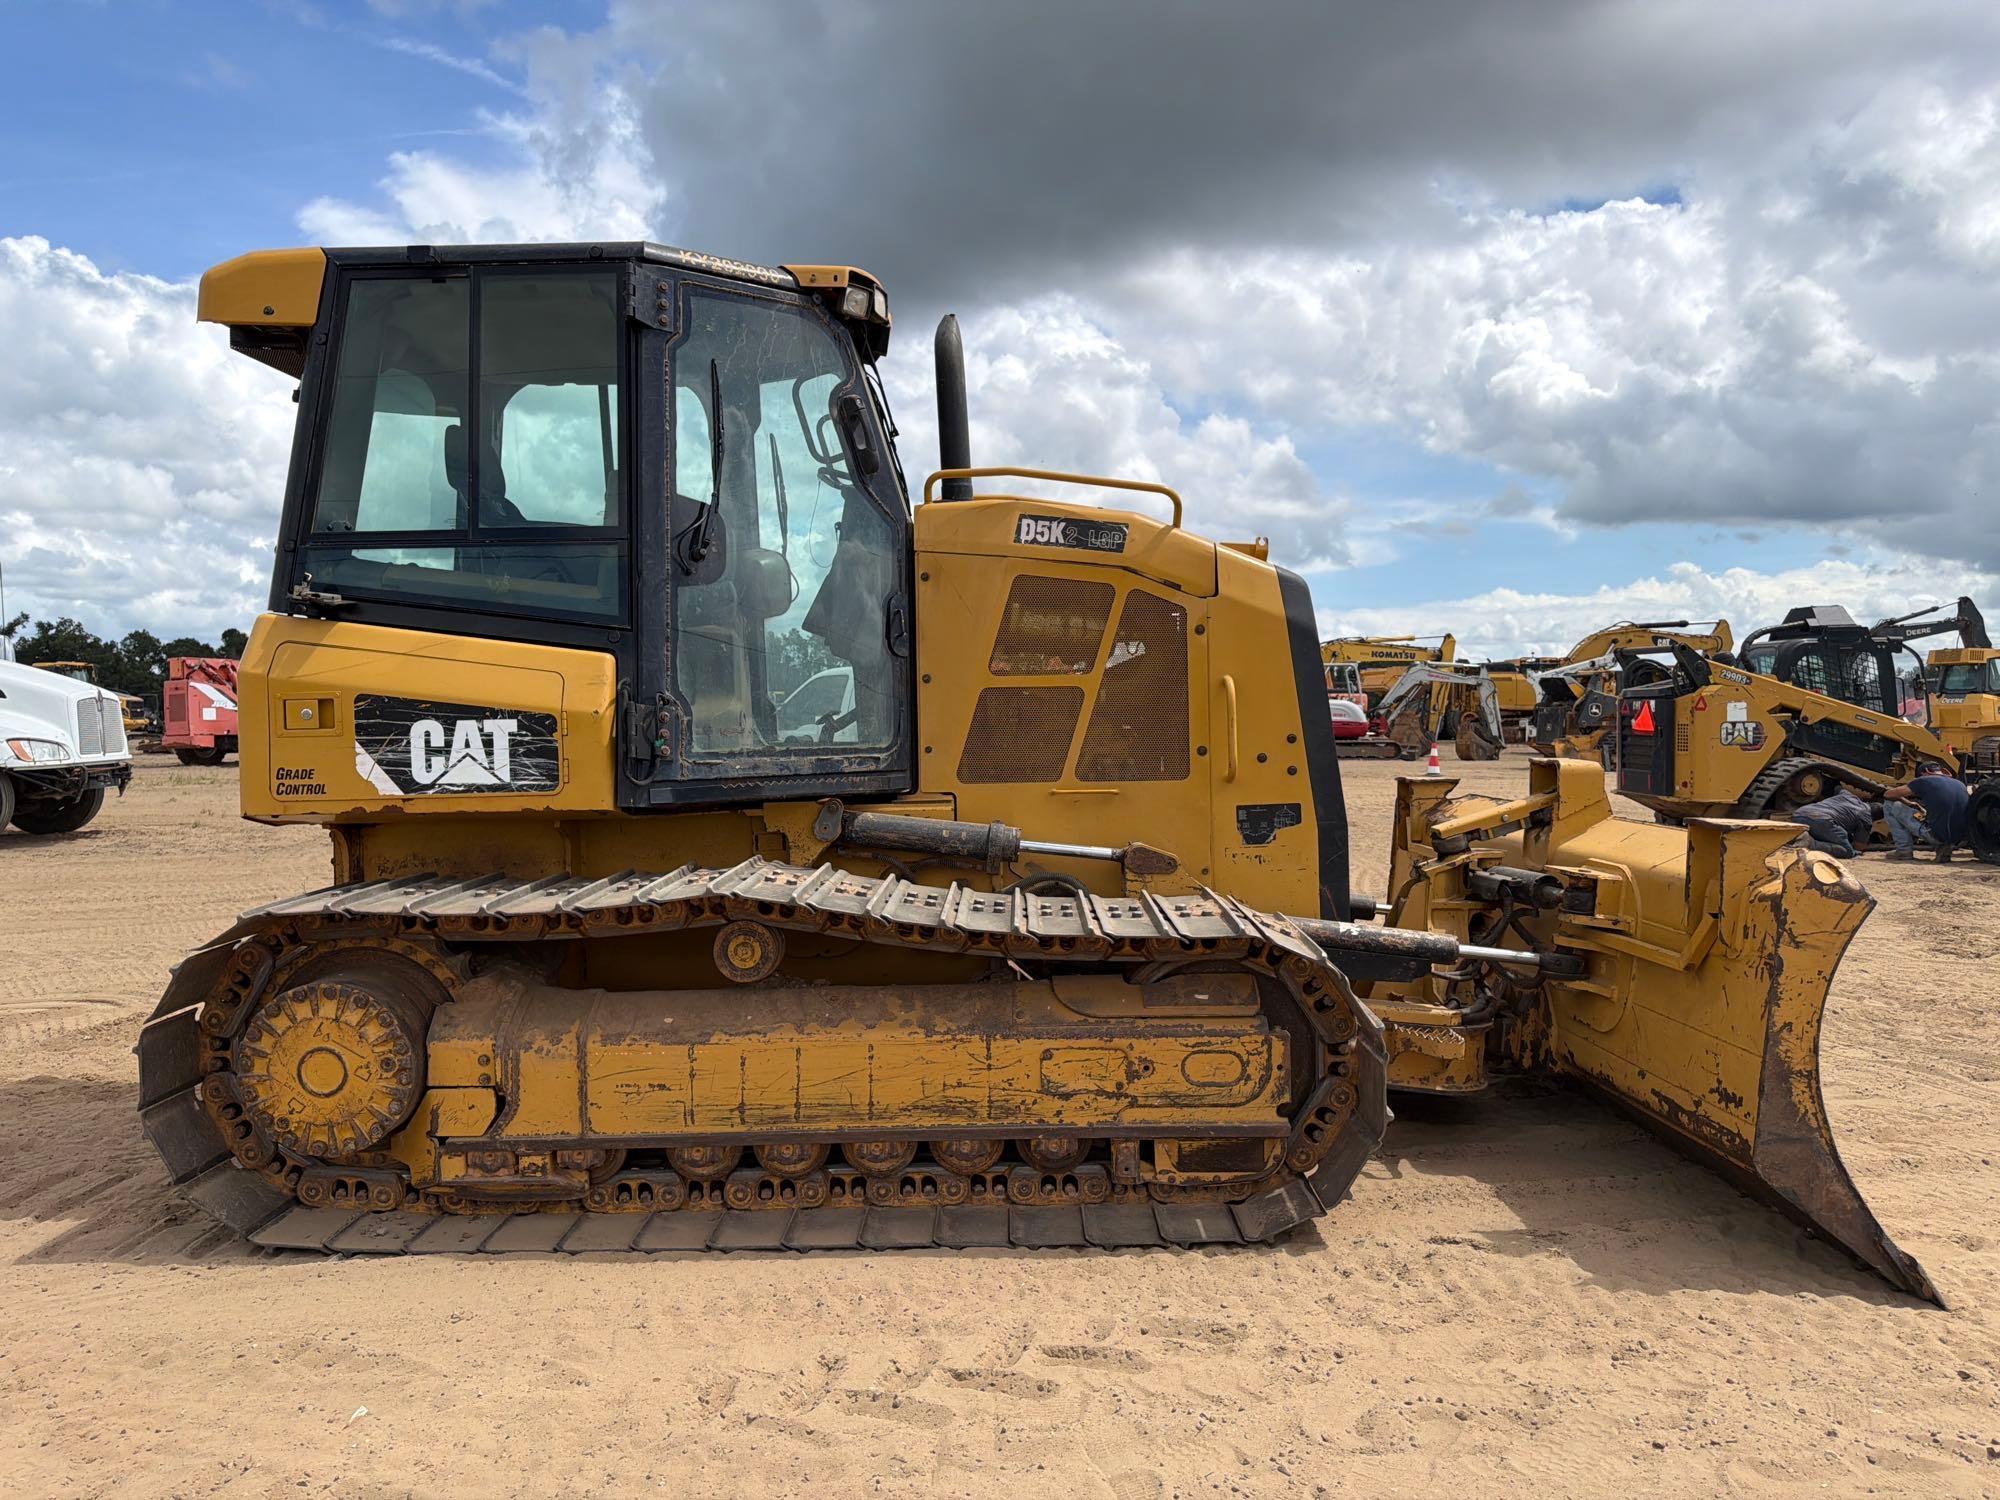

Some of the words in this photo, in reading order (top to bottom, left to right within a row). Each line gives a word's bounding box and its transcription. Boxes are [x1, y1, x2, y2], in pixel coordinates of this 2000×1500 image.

[1906, 627, 1932, 636] DEERE
[1657, 638, 1671, 647] CAT
[1371, 650, 1416, 660] KOMATSU
[1720, 669, 1747, 685] 299D3
[1941, 697, 1965, 705] DEERE
[1721, 722, 1757, 746] CAT
[410, 719, 518, 785] CAT
[276, 767, 315, 781] GRADE
[276, 782, 327, 796] CONTROL
